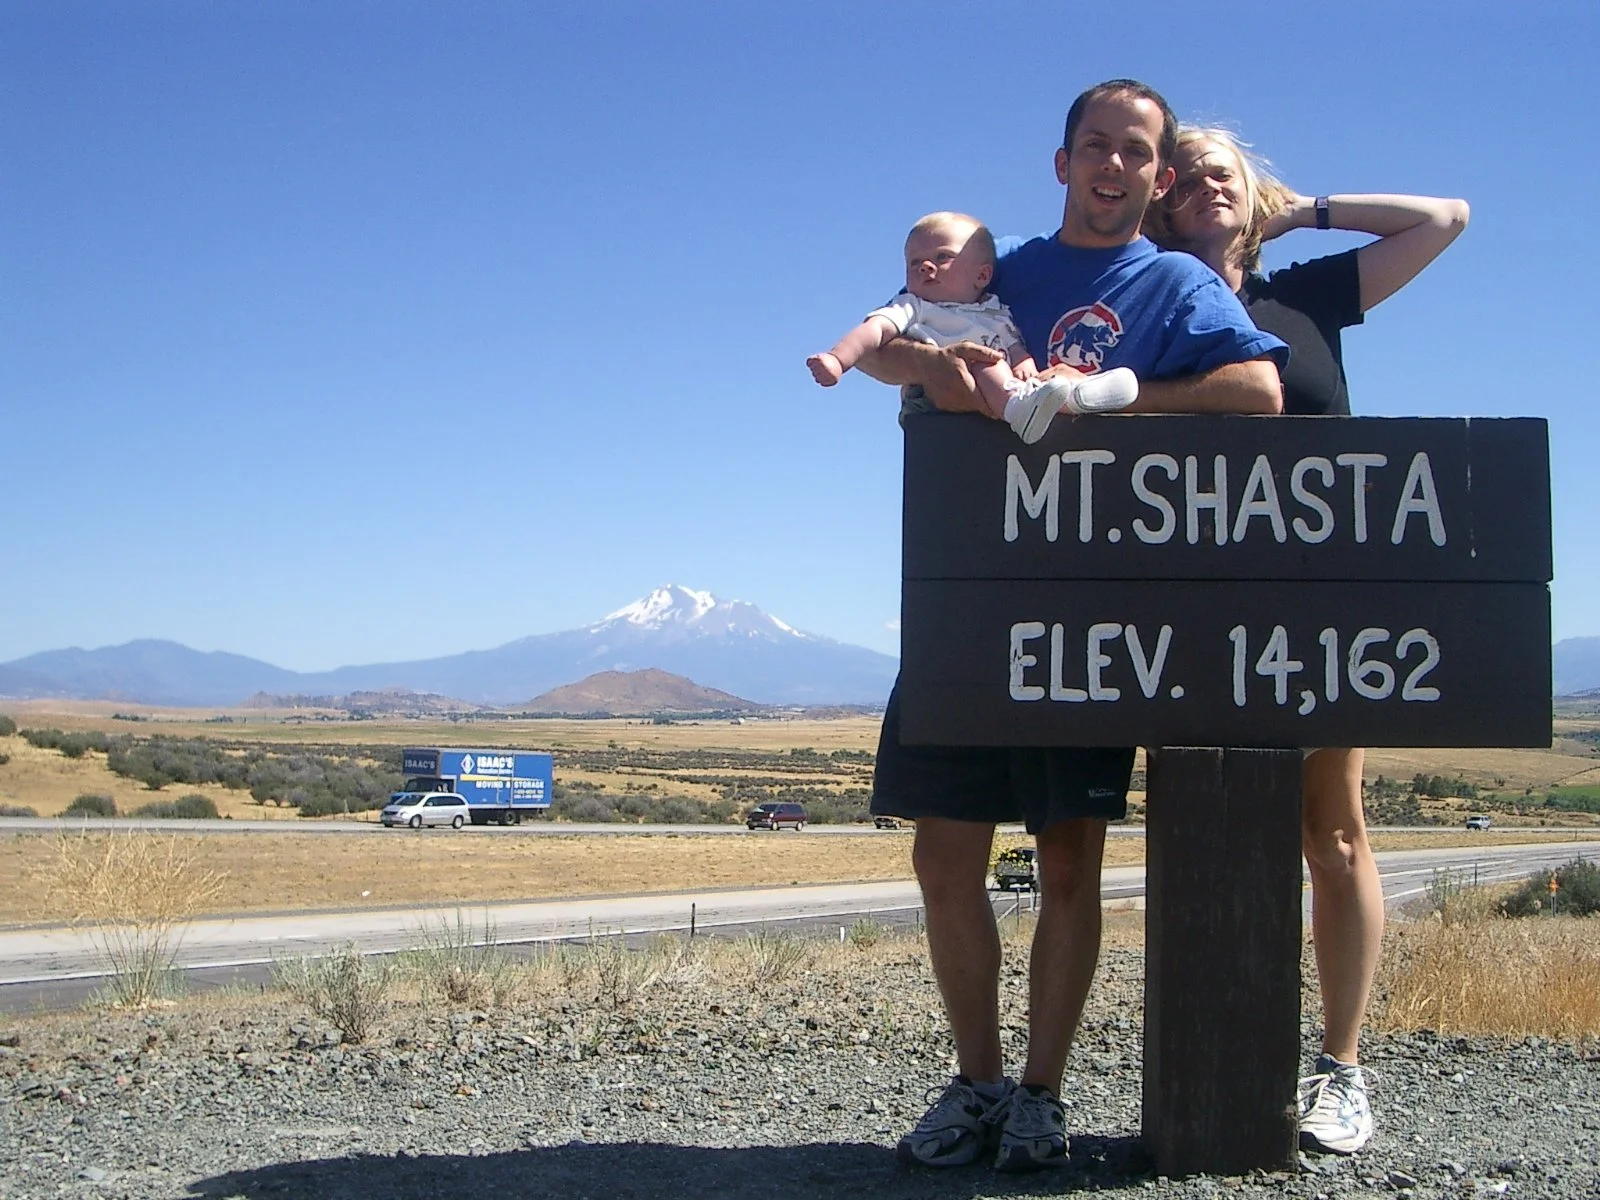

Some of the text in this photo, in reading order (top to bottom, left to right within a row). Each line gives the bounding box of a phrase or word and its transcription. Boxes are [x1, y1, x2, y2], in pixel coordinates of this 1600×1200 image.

[1008, 622, 1441, 716] ELEV. 14,162
[405, 760, 435, 769] ISAAC'S
[477, 756, 513, 768] ISAAC'S
